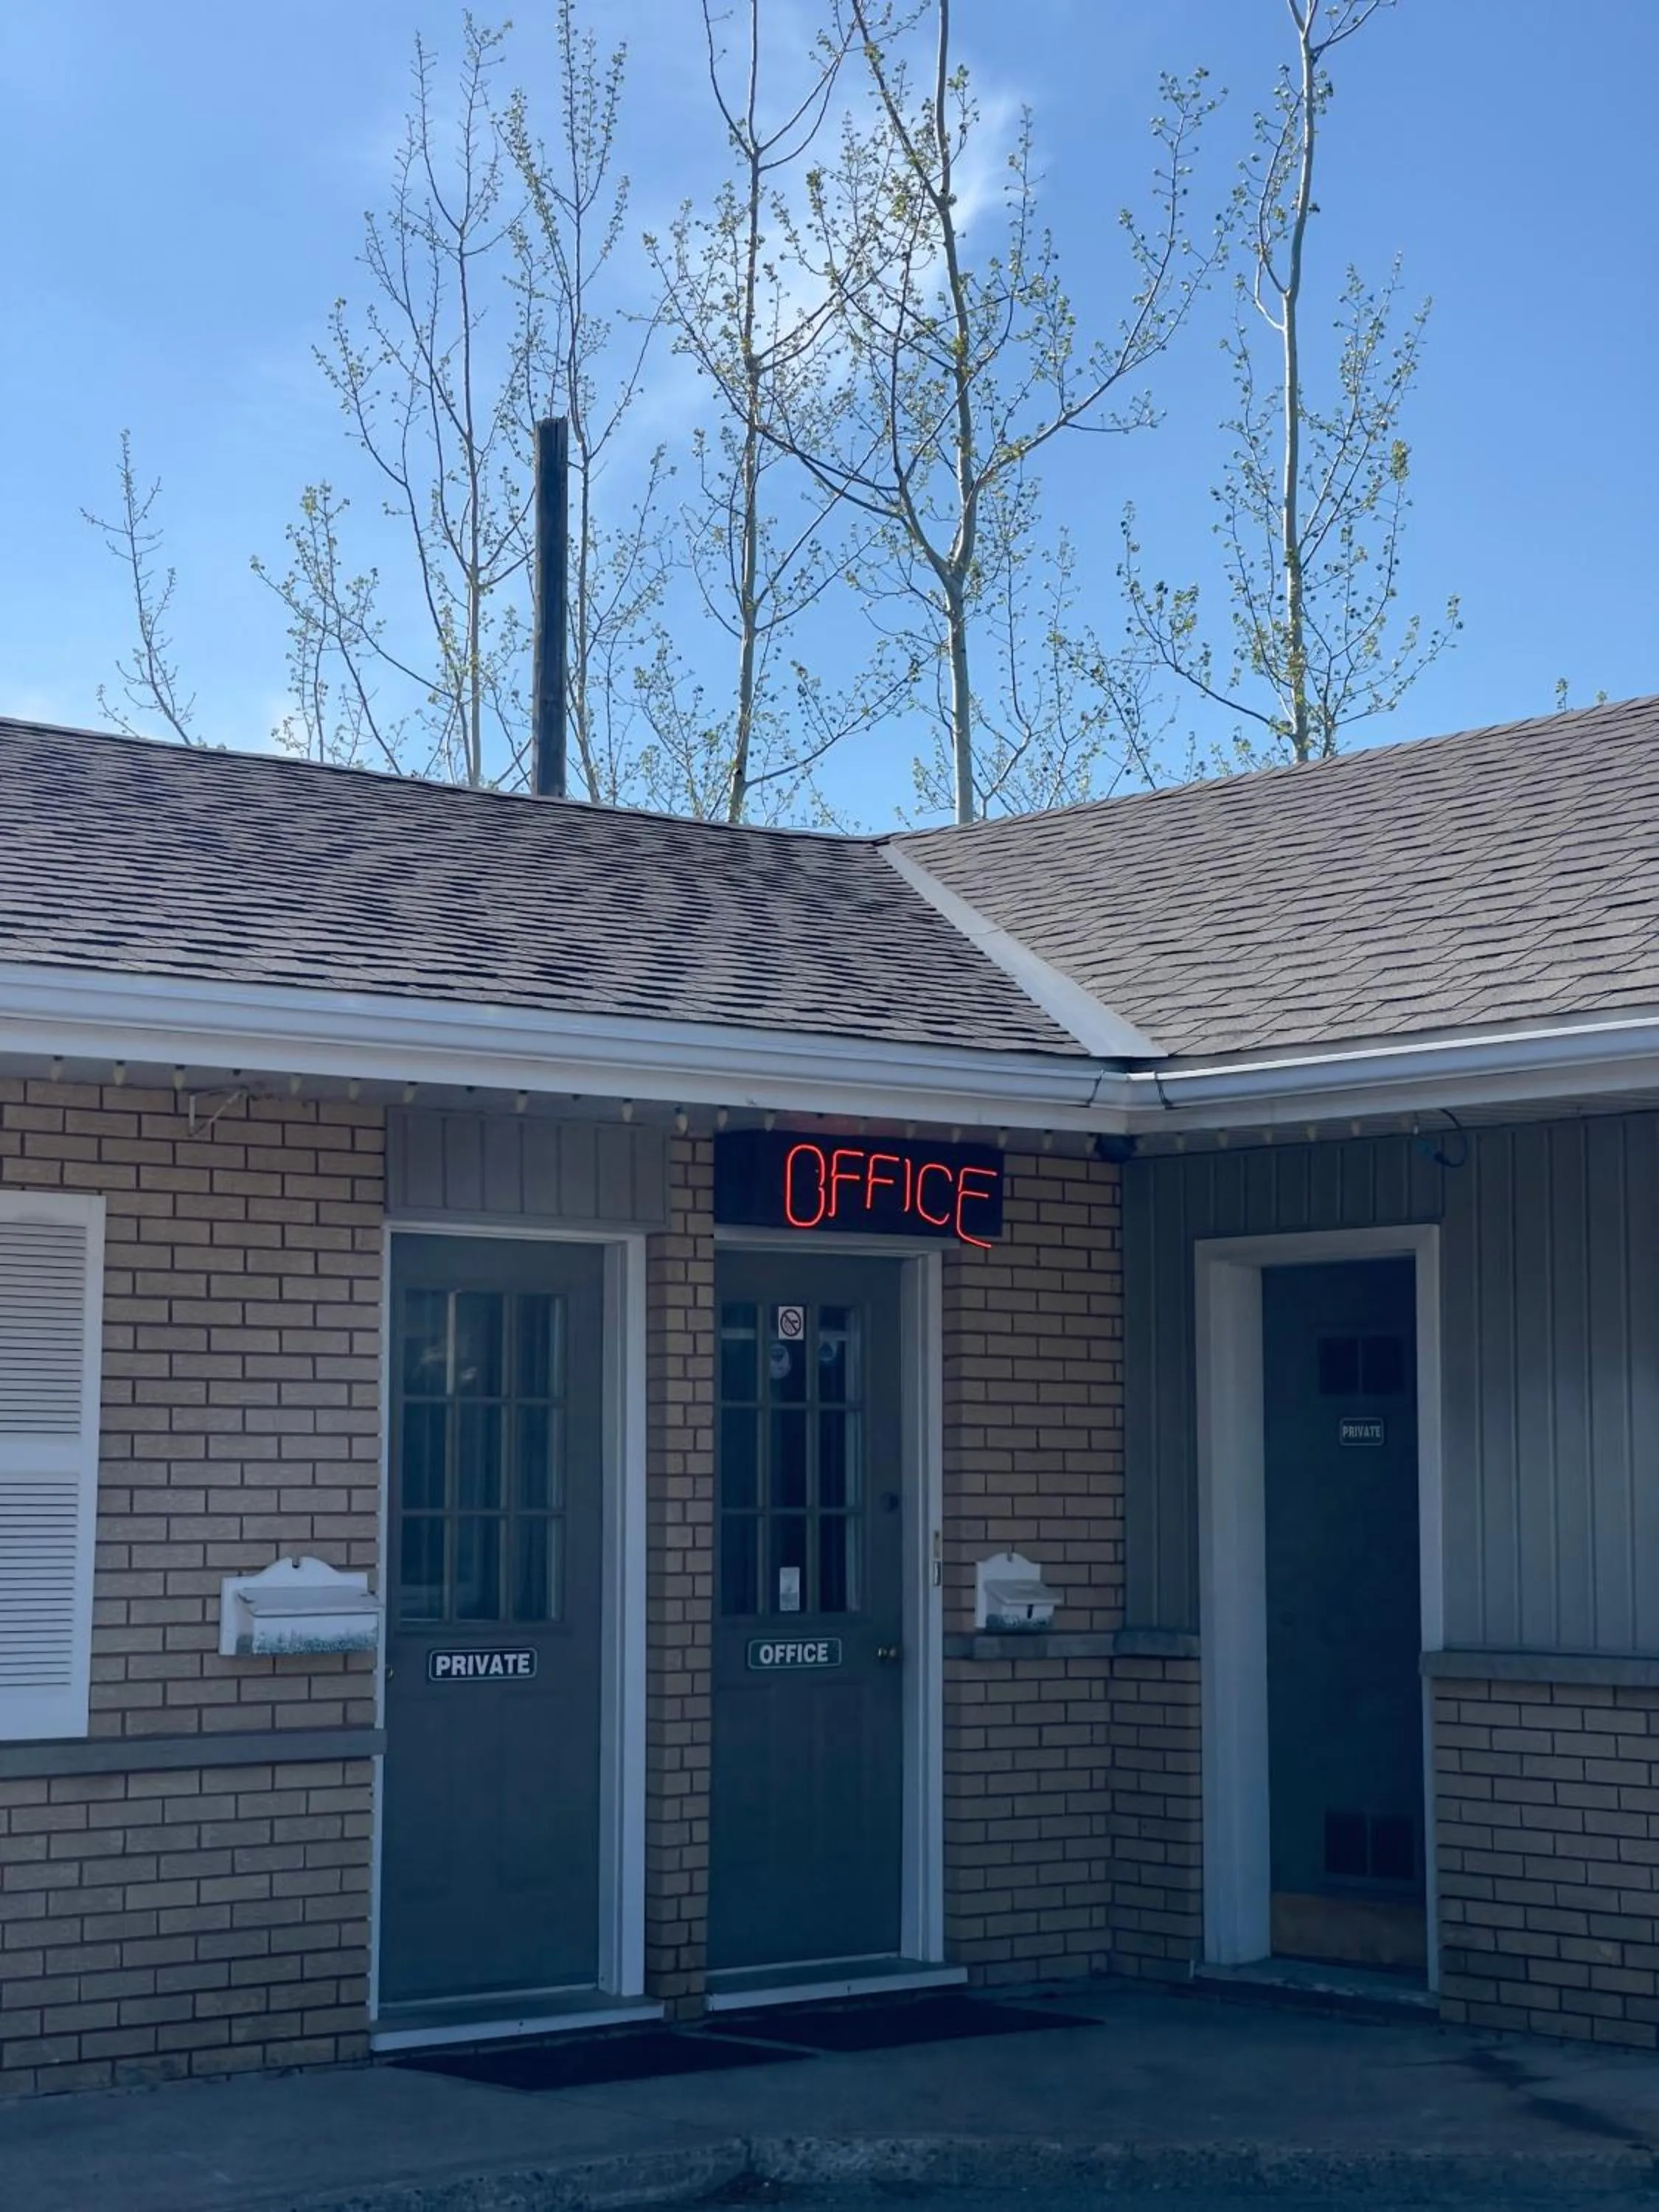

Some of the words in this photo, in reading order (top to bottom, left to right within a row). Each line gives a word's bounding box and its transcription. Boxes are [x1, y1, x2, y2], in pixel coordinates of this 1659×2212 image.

[785, 1144, 997, 1248] OFFICE
[1342, 1425, 1381, 1438] PRIVATE
[436, 1653, 530, 1676] PRIVATE
[759, 1643, 829, 1664] OFFICE
